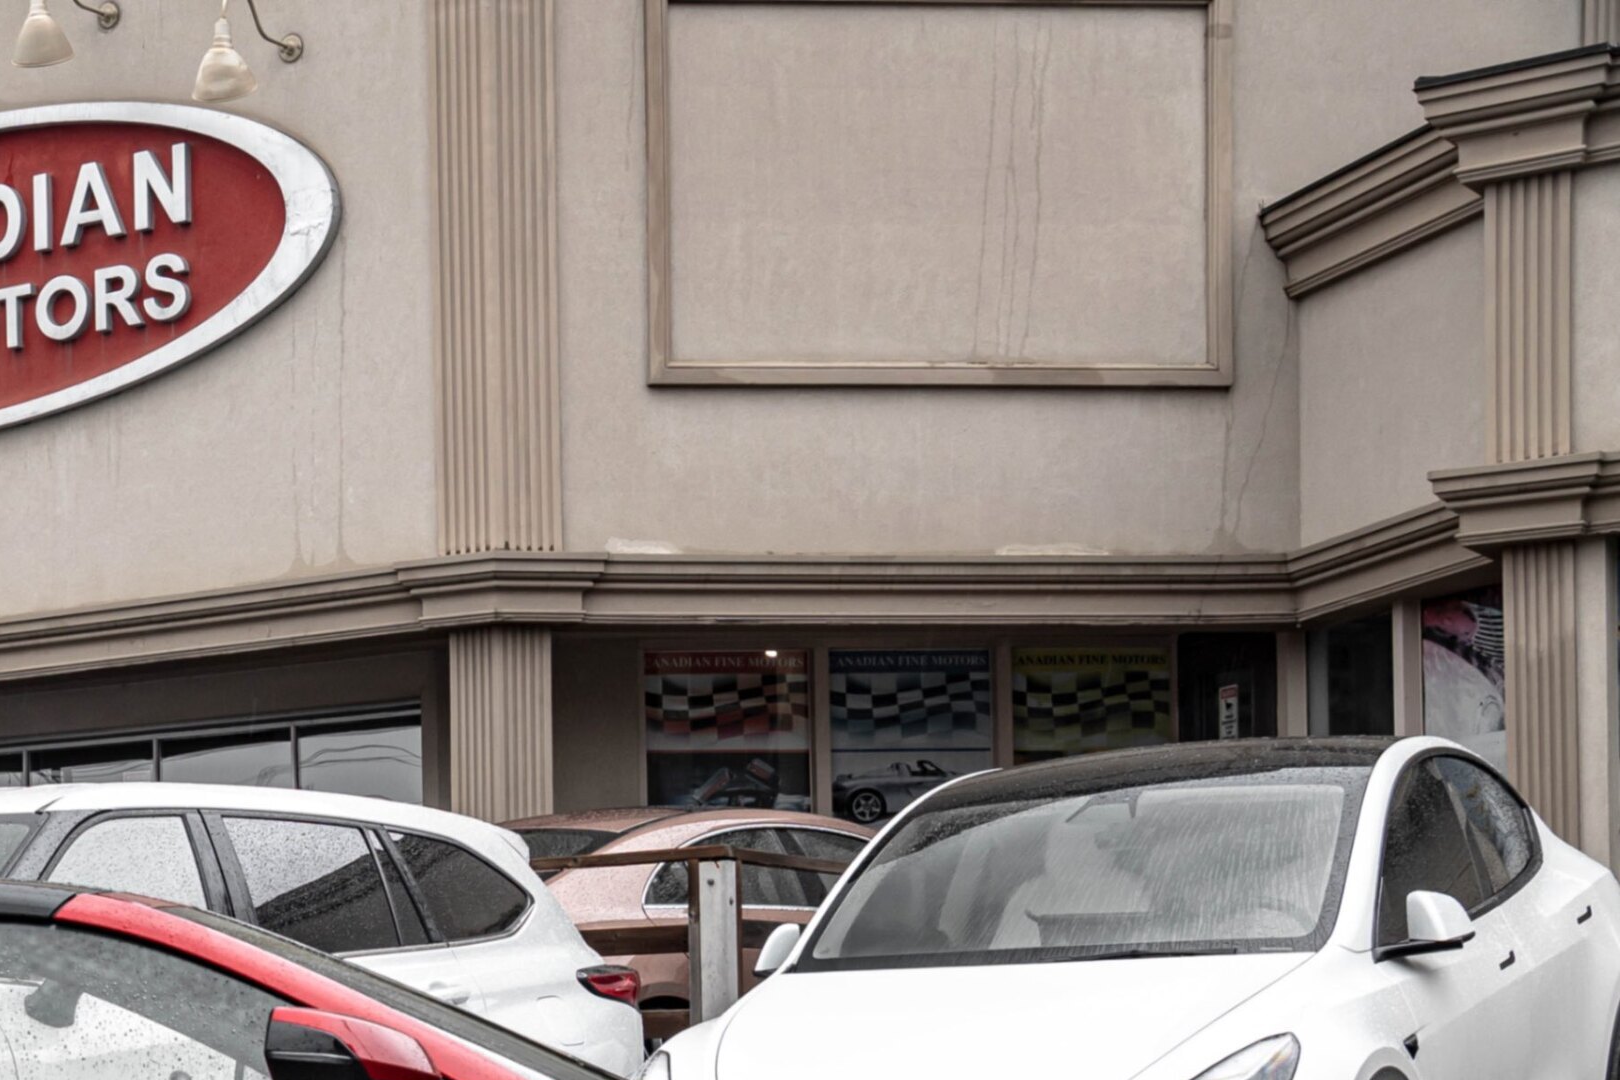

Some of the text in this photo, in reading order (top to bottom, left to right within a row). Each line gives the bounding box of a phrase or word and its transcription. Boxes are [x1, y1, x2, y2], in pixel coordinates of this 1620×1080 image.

[715, 656, 744, 667] FINE
[748, 656, 805, 667] MOTORS
[898, 655, 929, 666] FINE
[931, 655, 987, 666] MOTORS
[1078, 654, 1108, 665] FINE
[1112, 654, 1167, 665] MOTORS
